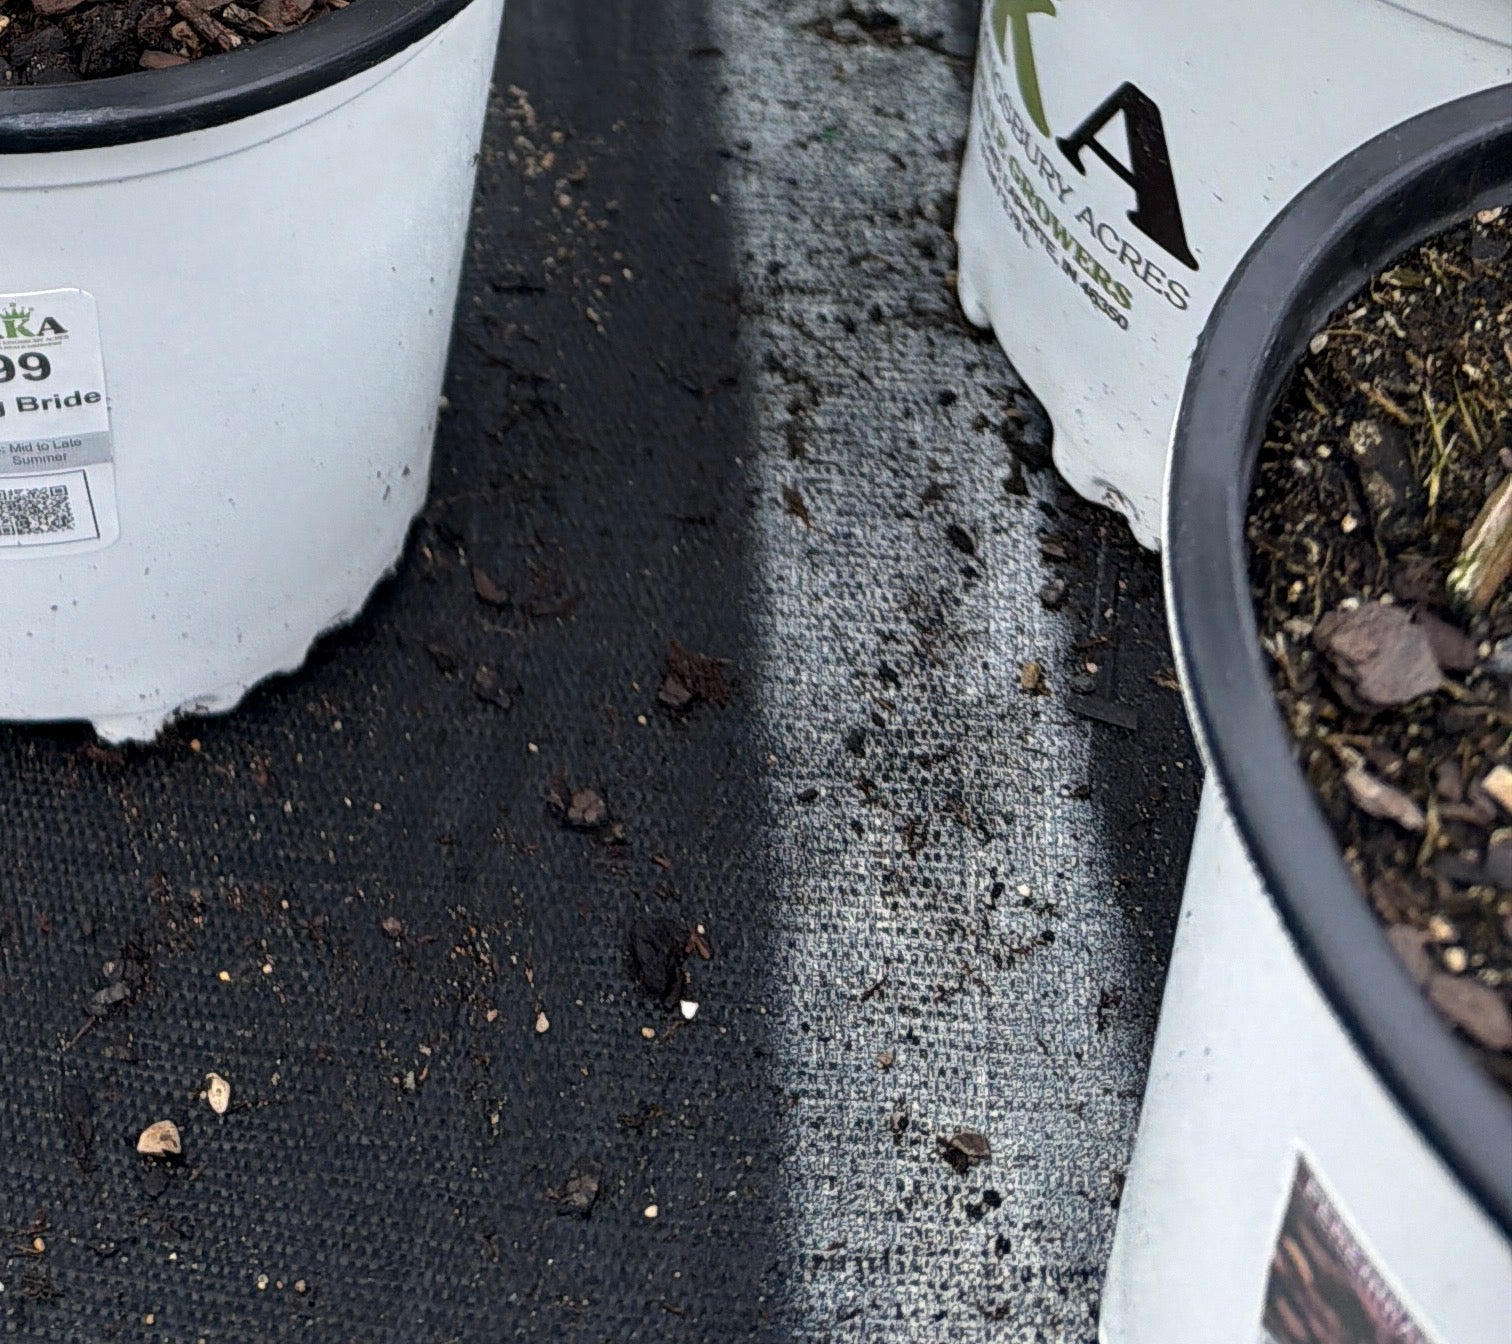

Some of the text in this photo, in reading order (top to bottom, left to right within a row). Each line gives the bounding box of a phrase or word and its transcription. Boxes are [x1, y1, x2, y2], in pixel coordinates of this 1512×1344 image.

[1008, 154, 1134, 311] GROWERS
[1075, 205, 1190, 310] ACRES
[15, 389, 102, 413] Bride
[8, 438, 33, 454] Mid
[12, 452, 68, 466] Summer
